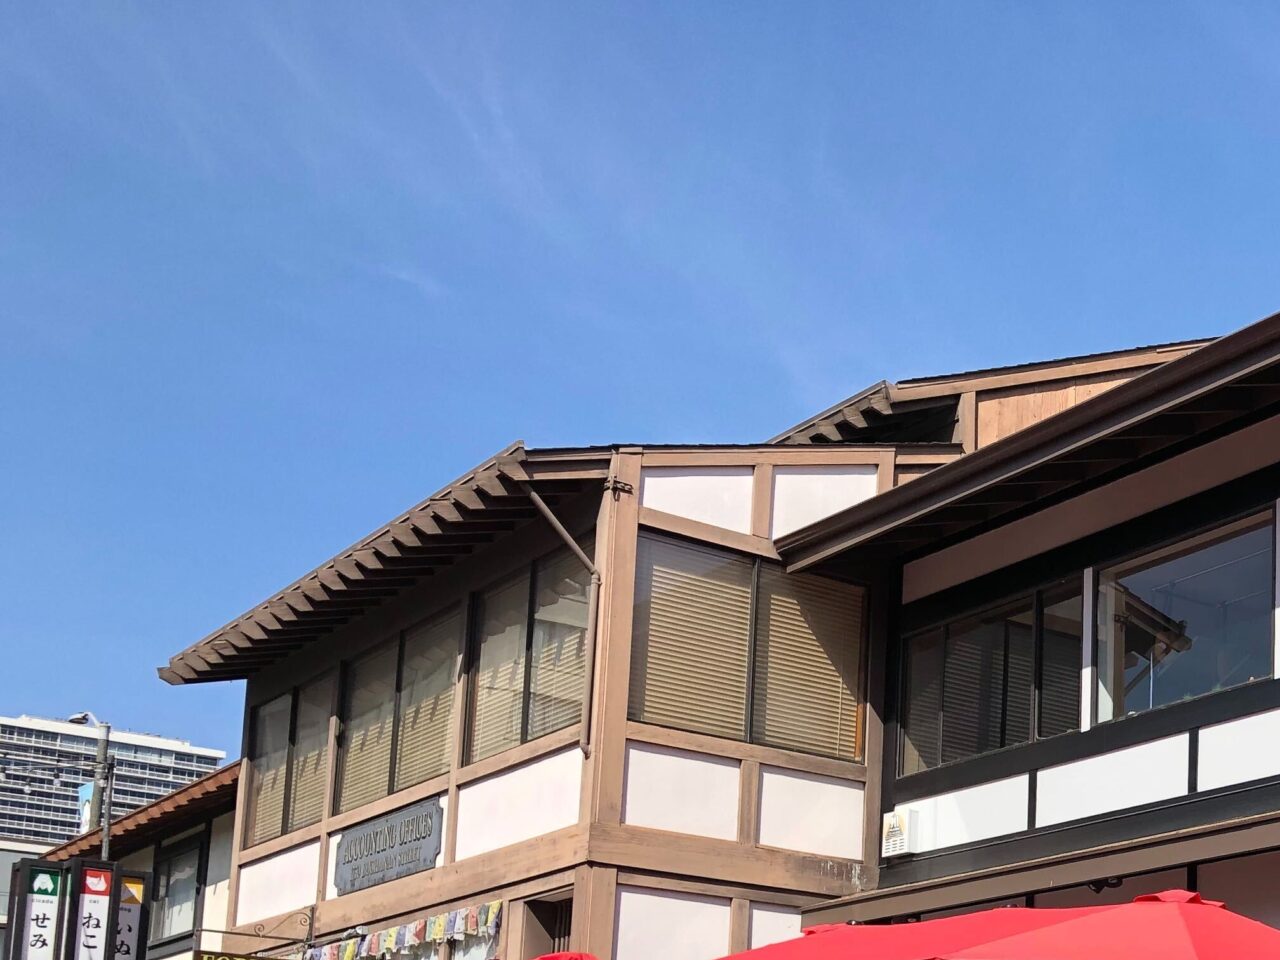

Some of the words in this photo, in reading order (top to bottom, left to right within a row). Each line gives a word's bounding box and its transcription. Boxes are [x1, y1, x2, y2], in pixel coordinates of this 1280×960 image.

[342, 823, 396, 866] ACCOUNTING
[399, 811, 434, 846] OFFICES
[30, 912, 51, 949] せみ
[82, 912, 101, 949] ねこ
